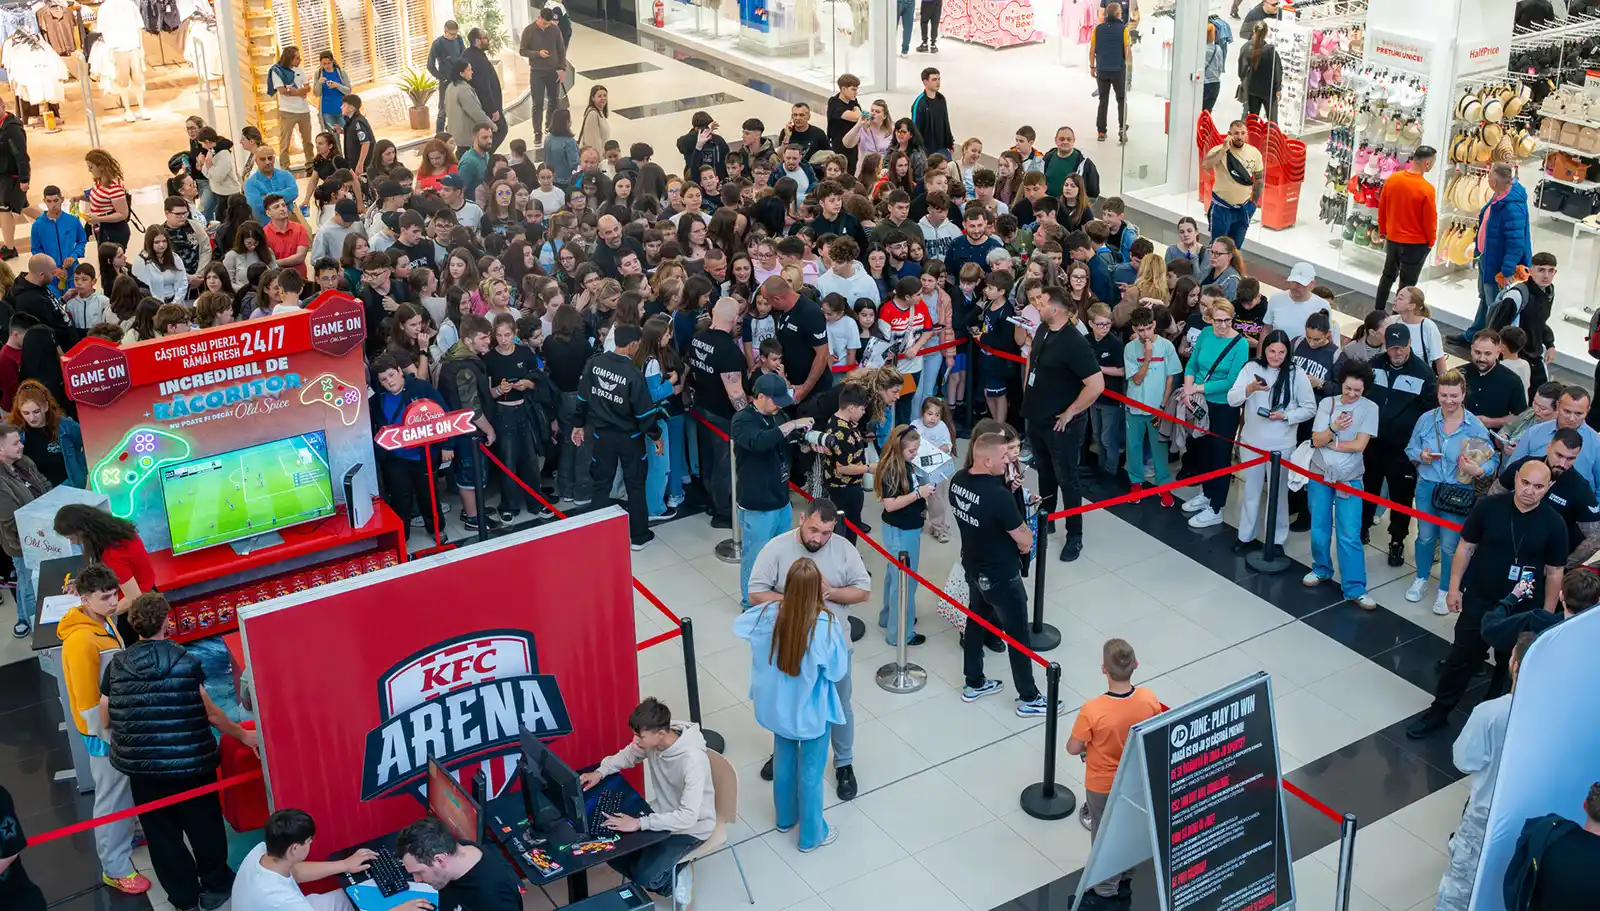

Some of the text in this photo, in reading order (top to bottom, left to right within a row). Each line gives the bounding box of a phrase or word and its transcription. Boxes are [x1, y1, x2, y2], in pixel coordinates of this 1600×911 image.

[1470, 46, 1500, 59] HalfPrice
[313, 316, 361, 337] GAME ON
[154, 325, 284, 361] CÂȘTIGI SAU PIERZI, 24/7
[213, 348, 240, 362] FRESH
[71, 364, 126, 388] GAME ON
[159, 356, 288, 396] INCREDIBIL DE
[592, 366, 626, 386] COMPANIA
[1306, 360, 1328, 380] YORK
[152, 373, 302, 420] RĂCORITOR
[614, 395, 624, 404] RO
[181, 417, 203, 427] POATE
[235, 402, 258, 419] Old
[260, 398, 290, 414] Spice
[408, 414, 422, 425] Old
[402, 420, 452, 442] GAME ON
[951, 483, 980, 505] COMPANIA
[970, 516, 980, 527] RO
[24, 535, 62, 554] Old Spice
[420, 648, 497, 692] KFC
[1172, 694, 1256, 745] JD ZONE: PLAY TO WIN
[377, 680, 559, 786] ARENA
